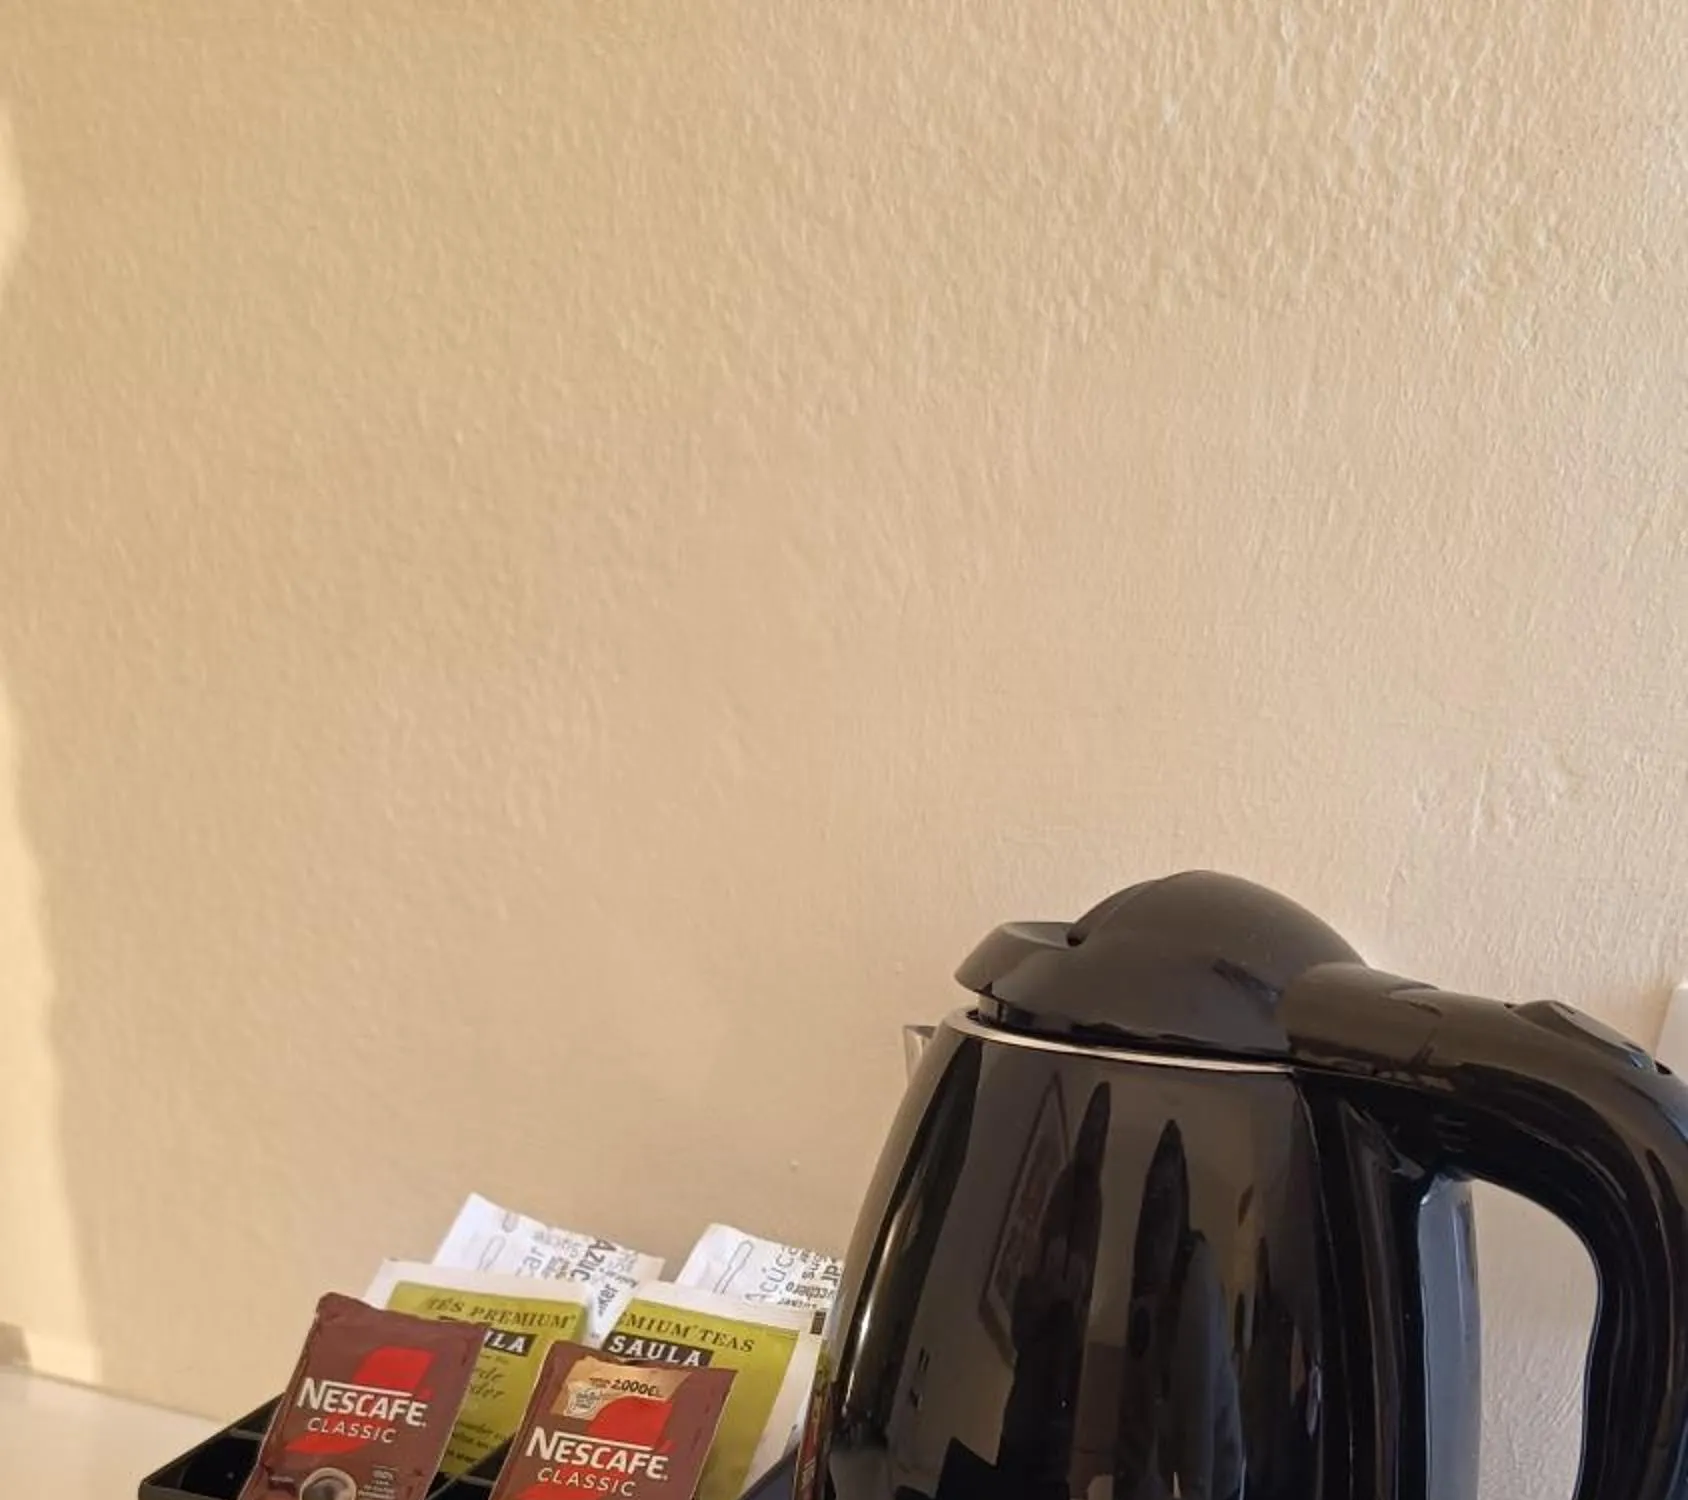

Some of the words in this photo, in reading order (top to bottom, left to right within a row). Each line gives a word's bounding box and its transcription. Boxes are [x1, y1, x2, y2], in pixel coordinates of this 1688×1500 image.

[609, 1335, 705, 1368] SAULA
[697, 1327, 756, 1353] TEAS
[306, 1417, 397, 1443] CLASSIC
[537, 1467, 637, 1497] CLASSIC
